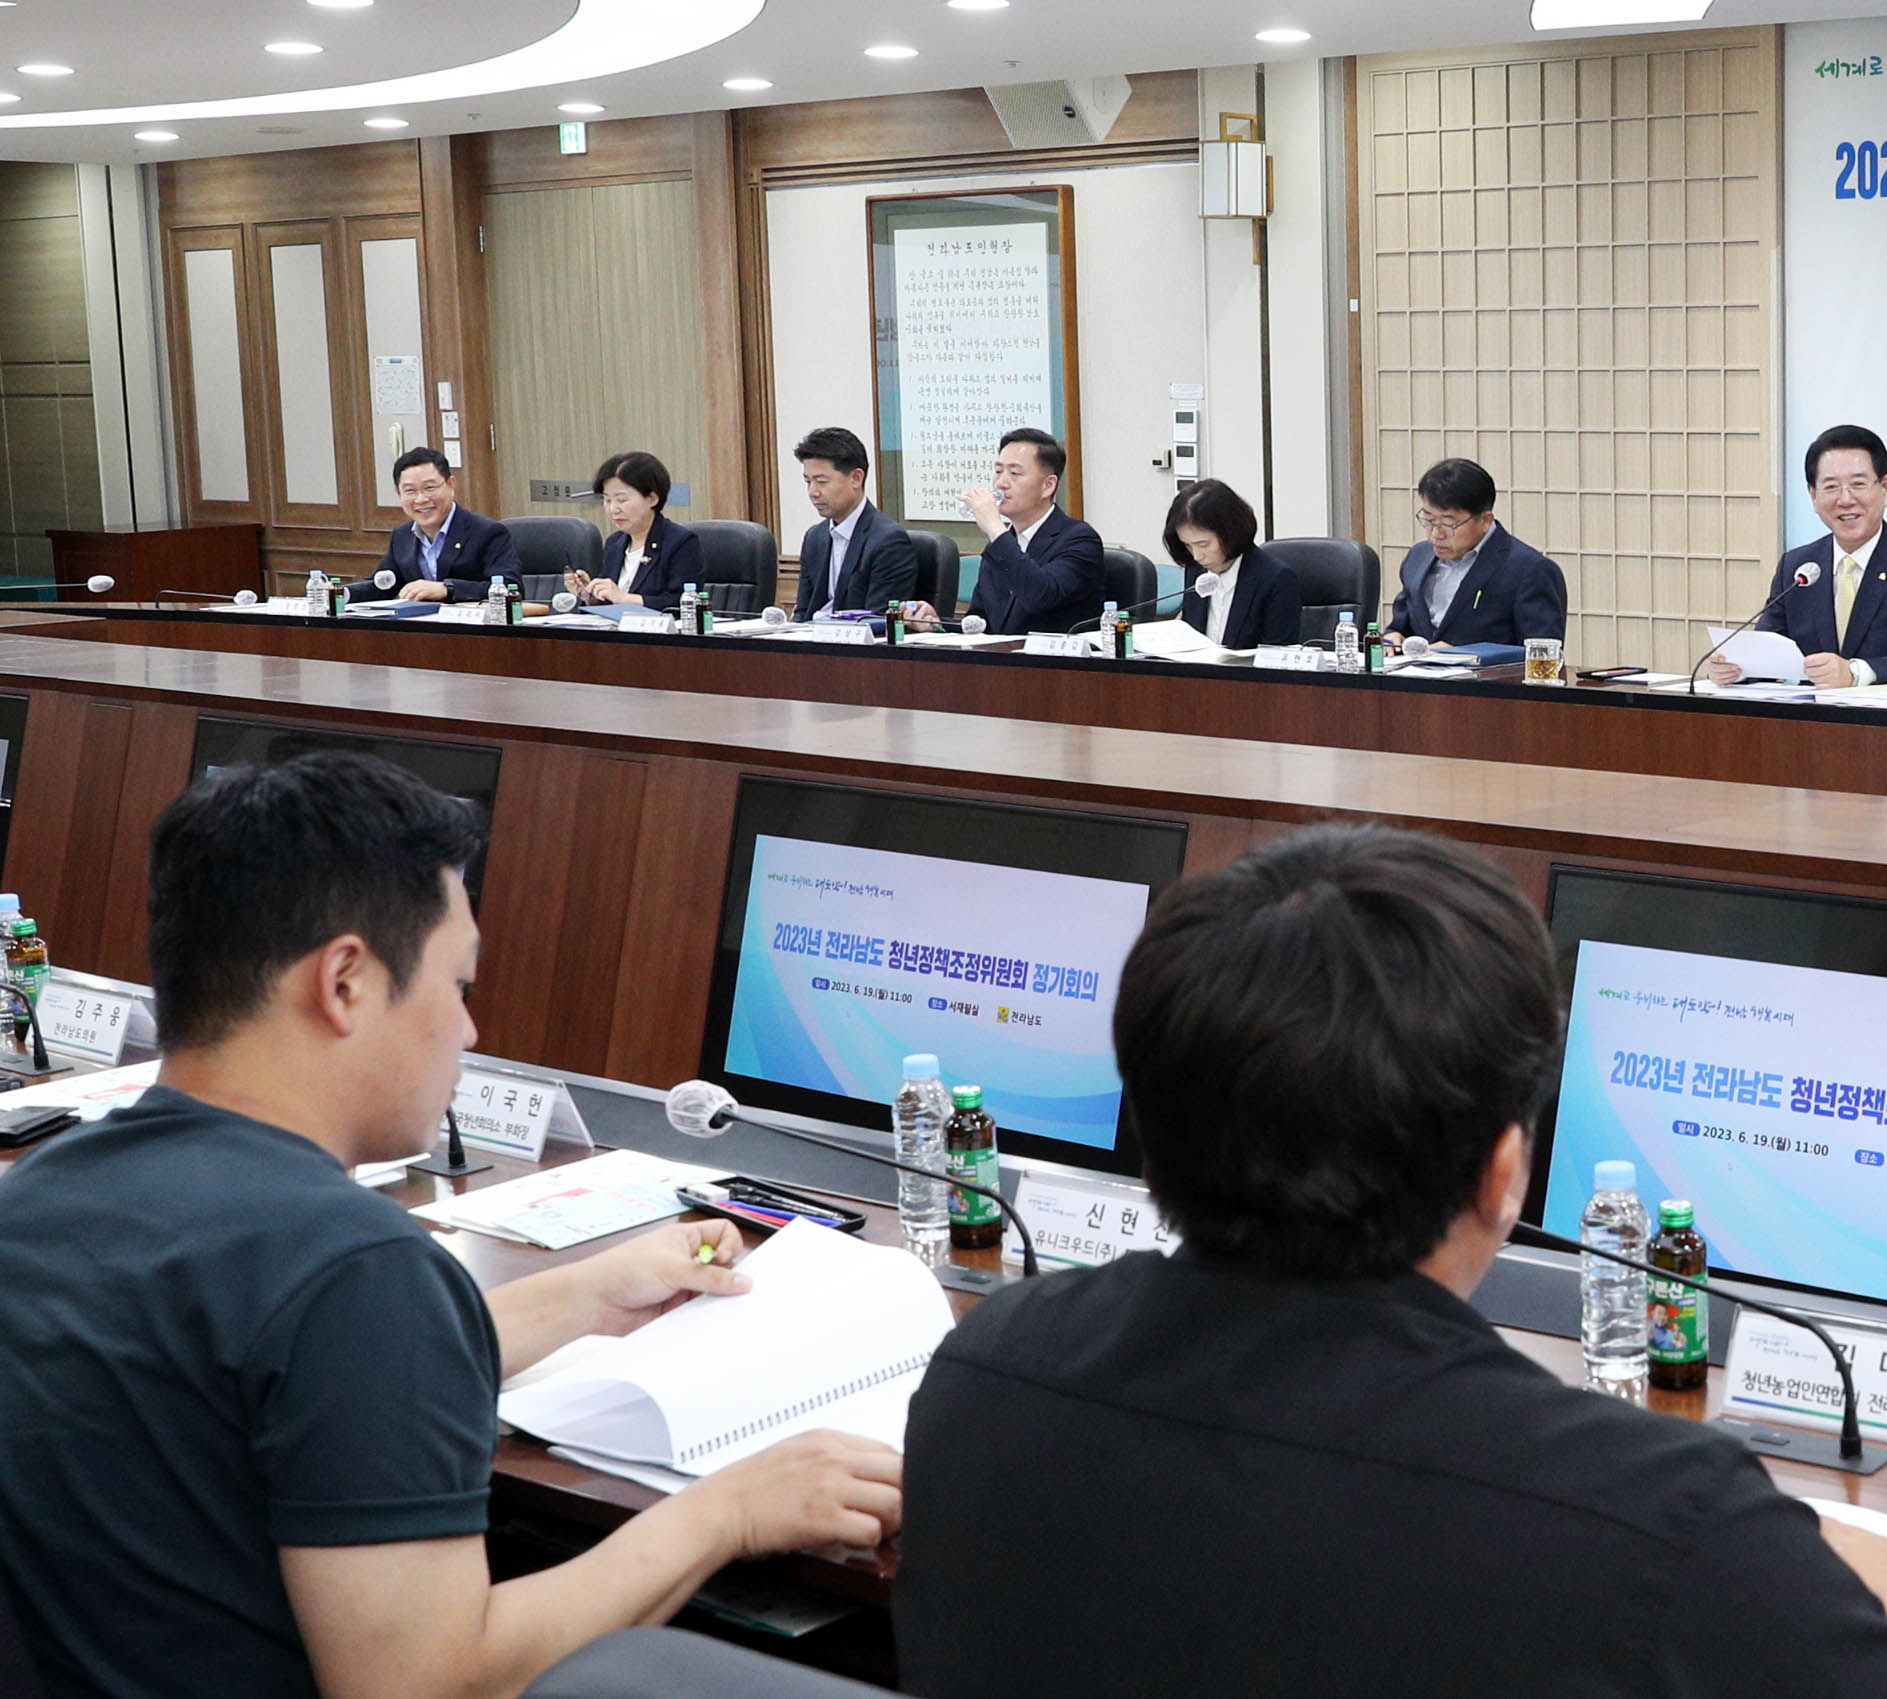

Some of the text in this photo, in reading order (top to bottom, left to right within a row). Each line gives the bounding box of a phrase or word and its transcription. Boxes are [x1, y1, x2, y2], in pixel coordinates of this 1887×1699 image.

[1814, 55, 1884, 79] 세계로
[773, 922, 1100, 1002] 2023년 전라남도 청년정책조정위원회 정기회의
[74, 999, 121, 1027] 김주웅
[831, 981, 853, 994] 2023.
[890, 990, 913, 1004] 11:00
[949, 1000, 980, 1017] 서재필실
[54, 1022, 97, 1044] 전라남도의원
[1011, 1010, 1042, 1027] 전라남도
[1610, 1050, 1686, 1095] 2023년
[1691, 1062, 1784, 1109] 전라남도
[1702, 1126, 1735, 1142] 2023.
[1738, 1131, 1749, 1144] 6.
[1752, 1134, 1792, 1152] 19.(월)
[1795, 1141, 1829, 1156] 11:00
[1034, 1229, 1117, 1261] 유니크우드(주)
[1741, 1370, 1860, 1407] 청년농업인연합
